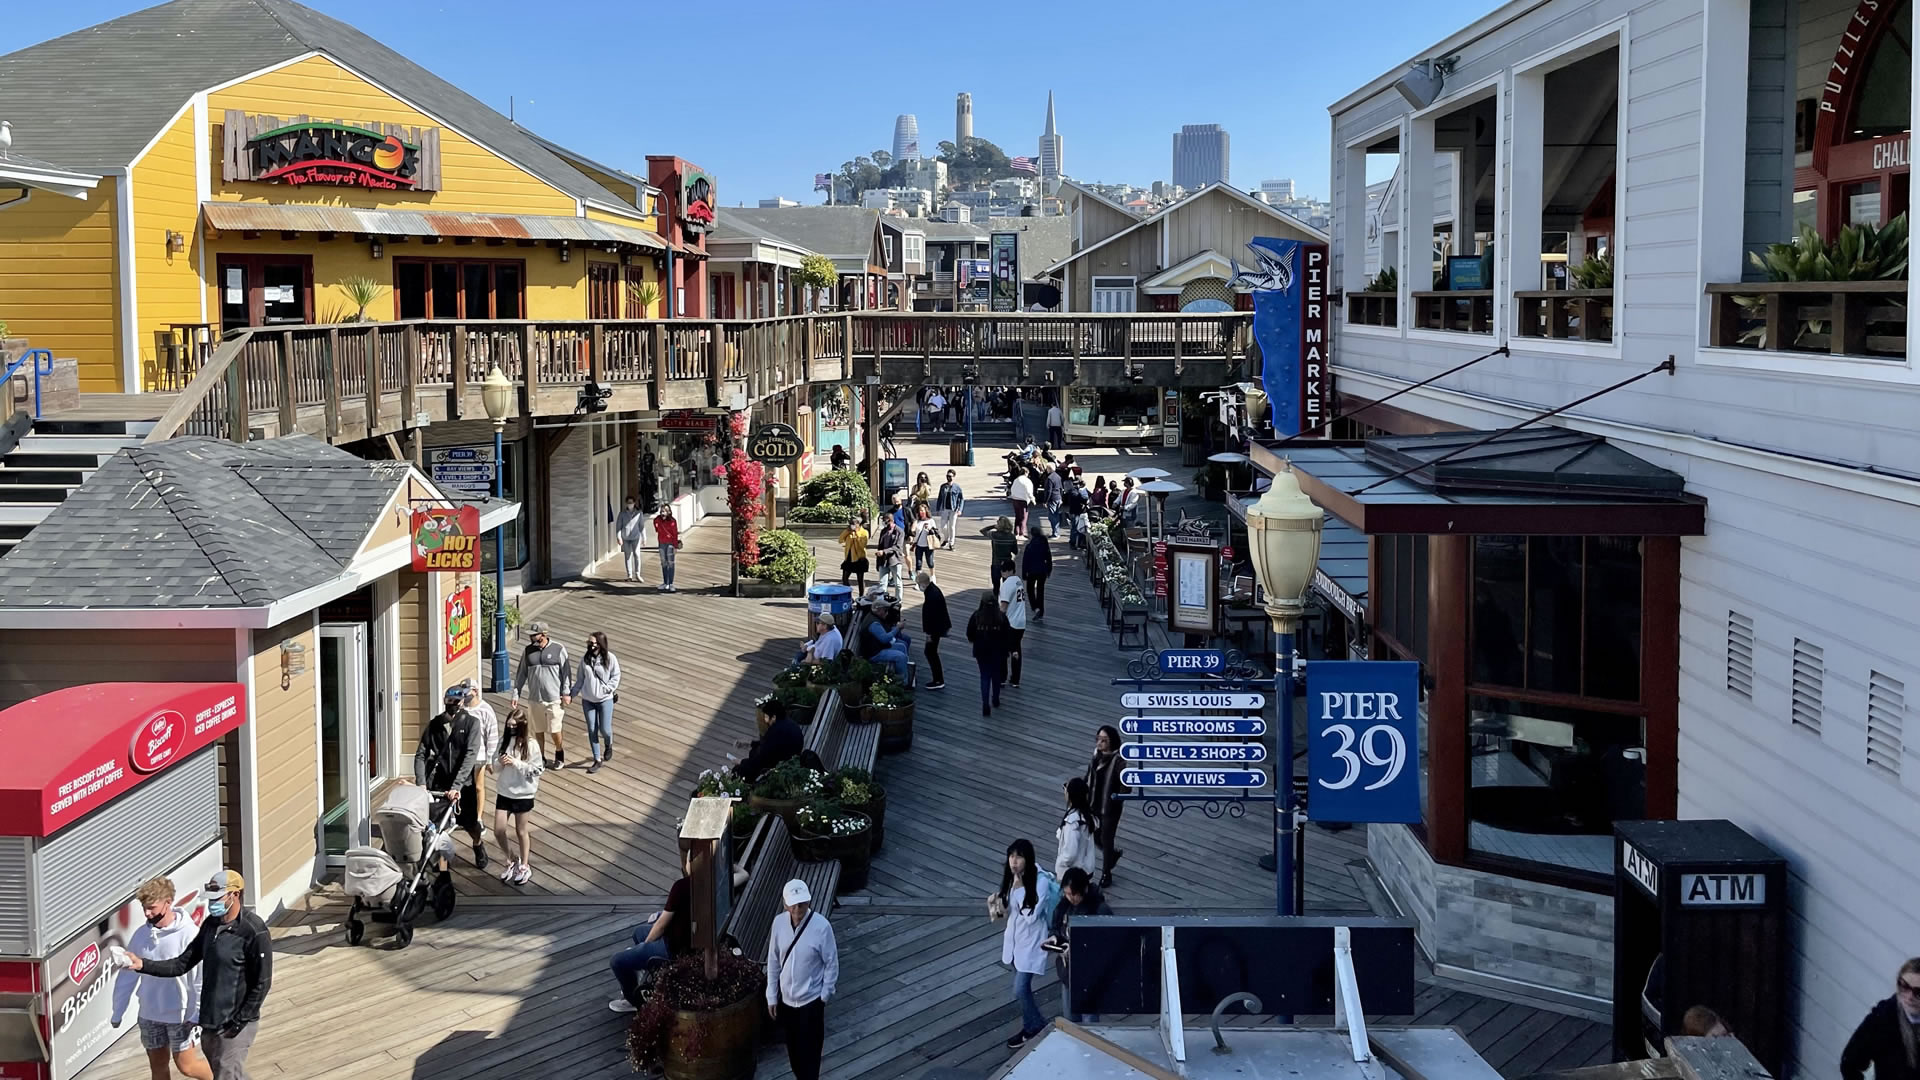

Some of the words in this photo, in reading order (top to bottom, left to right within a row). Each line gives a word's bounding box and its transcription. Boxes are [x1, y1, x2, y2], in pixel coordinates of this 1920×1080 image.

[283, 174, 308, 186] The
[308, 168, 342, 186] Flavor
[344, 172, 356, 184] of
[359, 173, 397, 190] Mexico
[1308, 252, 1322, 318] PIER
[1306, 328, 1321, 429] MARKET
[754, 443, 798, 457] GOLD
[443, 535, 477, 551] HOT
[426, 552, 474, 568] LICKS
[459, 614, 472, 632] HOT
[452, 632, 471, 654] LICKS
[1168, 655, 1203, 668] PIER
[1203, 653, 1219, 668] 39
[195, 708, 211, 723] COFFEE
[214, 695, 235, 714] ESPRESSO
[1148, 696, 1189, 707] SWISS
[1192, 696, 1232, 707] LOUIS
[1320, 691, 1402, 720] PIER
[194, 722, 206, 736] ICED
[205, 714, 221, 730] COFFEE
[1153, 721, 1236, 733] RESTROOMS
[147, 723, 174, 757] Biscoff
[1146, 748, 1187, 759] LEVEL
[1190, 748, 1198, 759] 2
[1200, 748, 1246, 759] SHOPS
[1318, 723, 1407, 791] 39
[58, 785, 73, 797] FREE
[73, 770, 96, 792] BISCOFF
[96, 759, 116, 777] COOKIE
[1154, 773, 1182, 785] BAY
[1183, 773, 1226, 785] VIEWS
[50, 794, 73, 815] SERVED
[73, 786, 88, 803] WITH
[88, 778, 104, 796] EVERY
[104, 767, 124, 786] COFFEE
[1627, 847, 1656, 892] ATM
[1688, 875, 1754, 901] ATM
[74, 949, 97, 978] Lotus
[60, 956, 115, 1033] Biscoff
